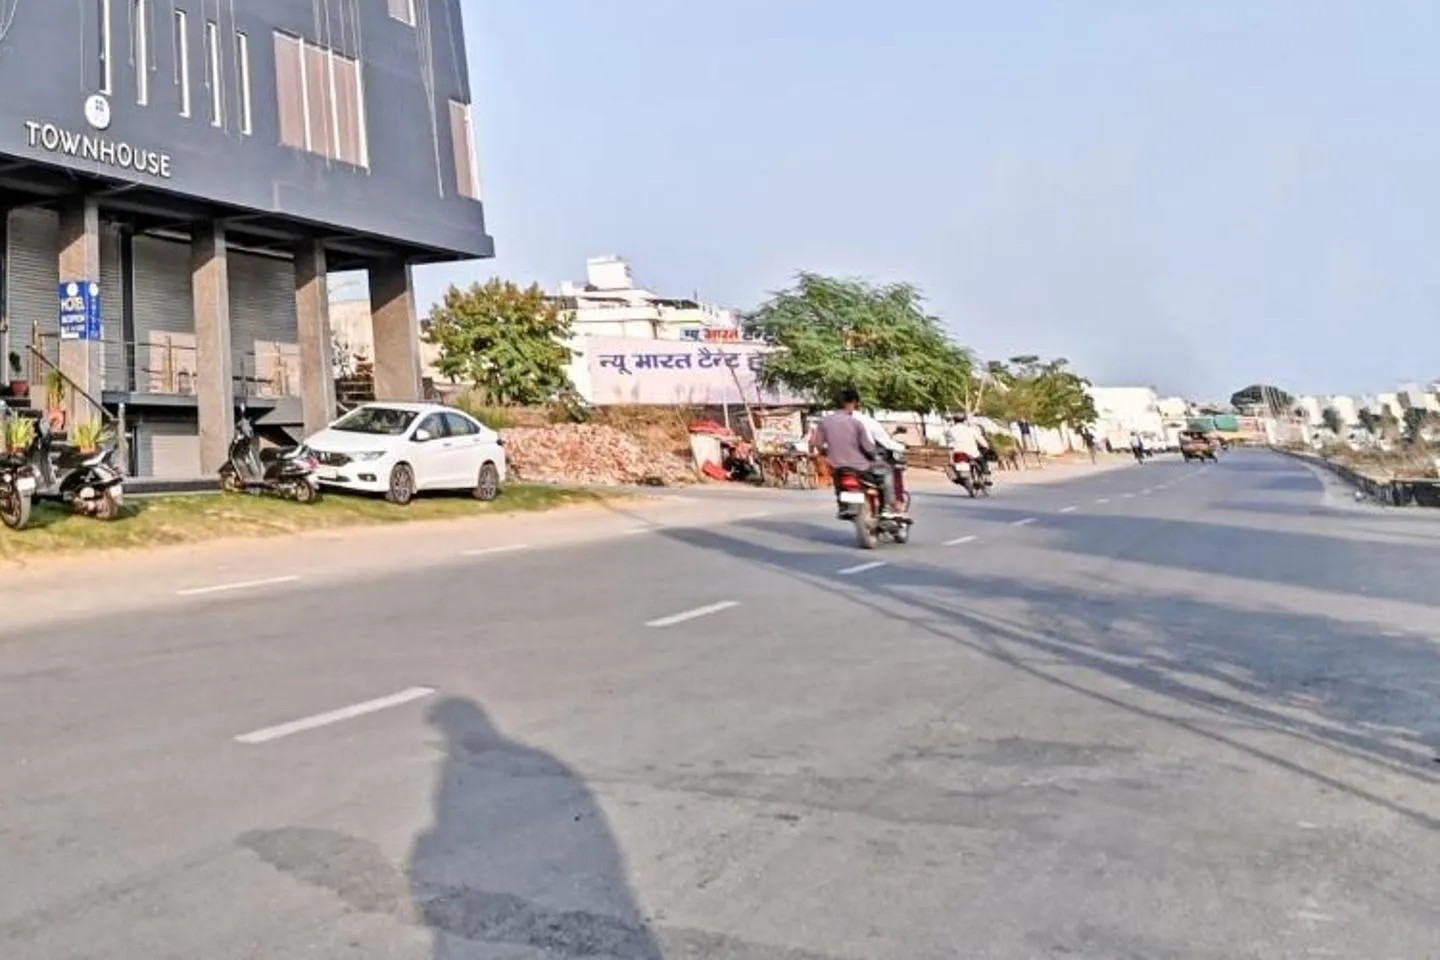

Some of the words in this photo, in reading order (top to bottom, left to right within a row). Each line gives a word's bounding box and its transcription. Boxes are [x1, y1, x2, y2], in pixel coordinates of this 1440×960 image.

[25, 120, 171, 177] TOWNHOUSE
[598, 353, 633, 375] न्यू
[634, 353, 691, 369] भारत
